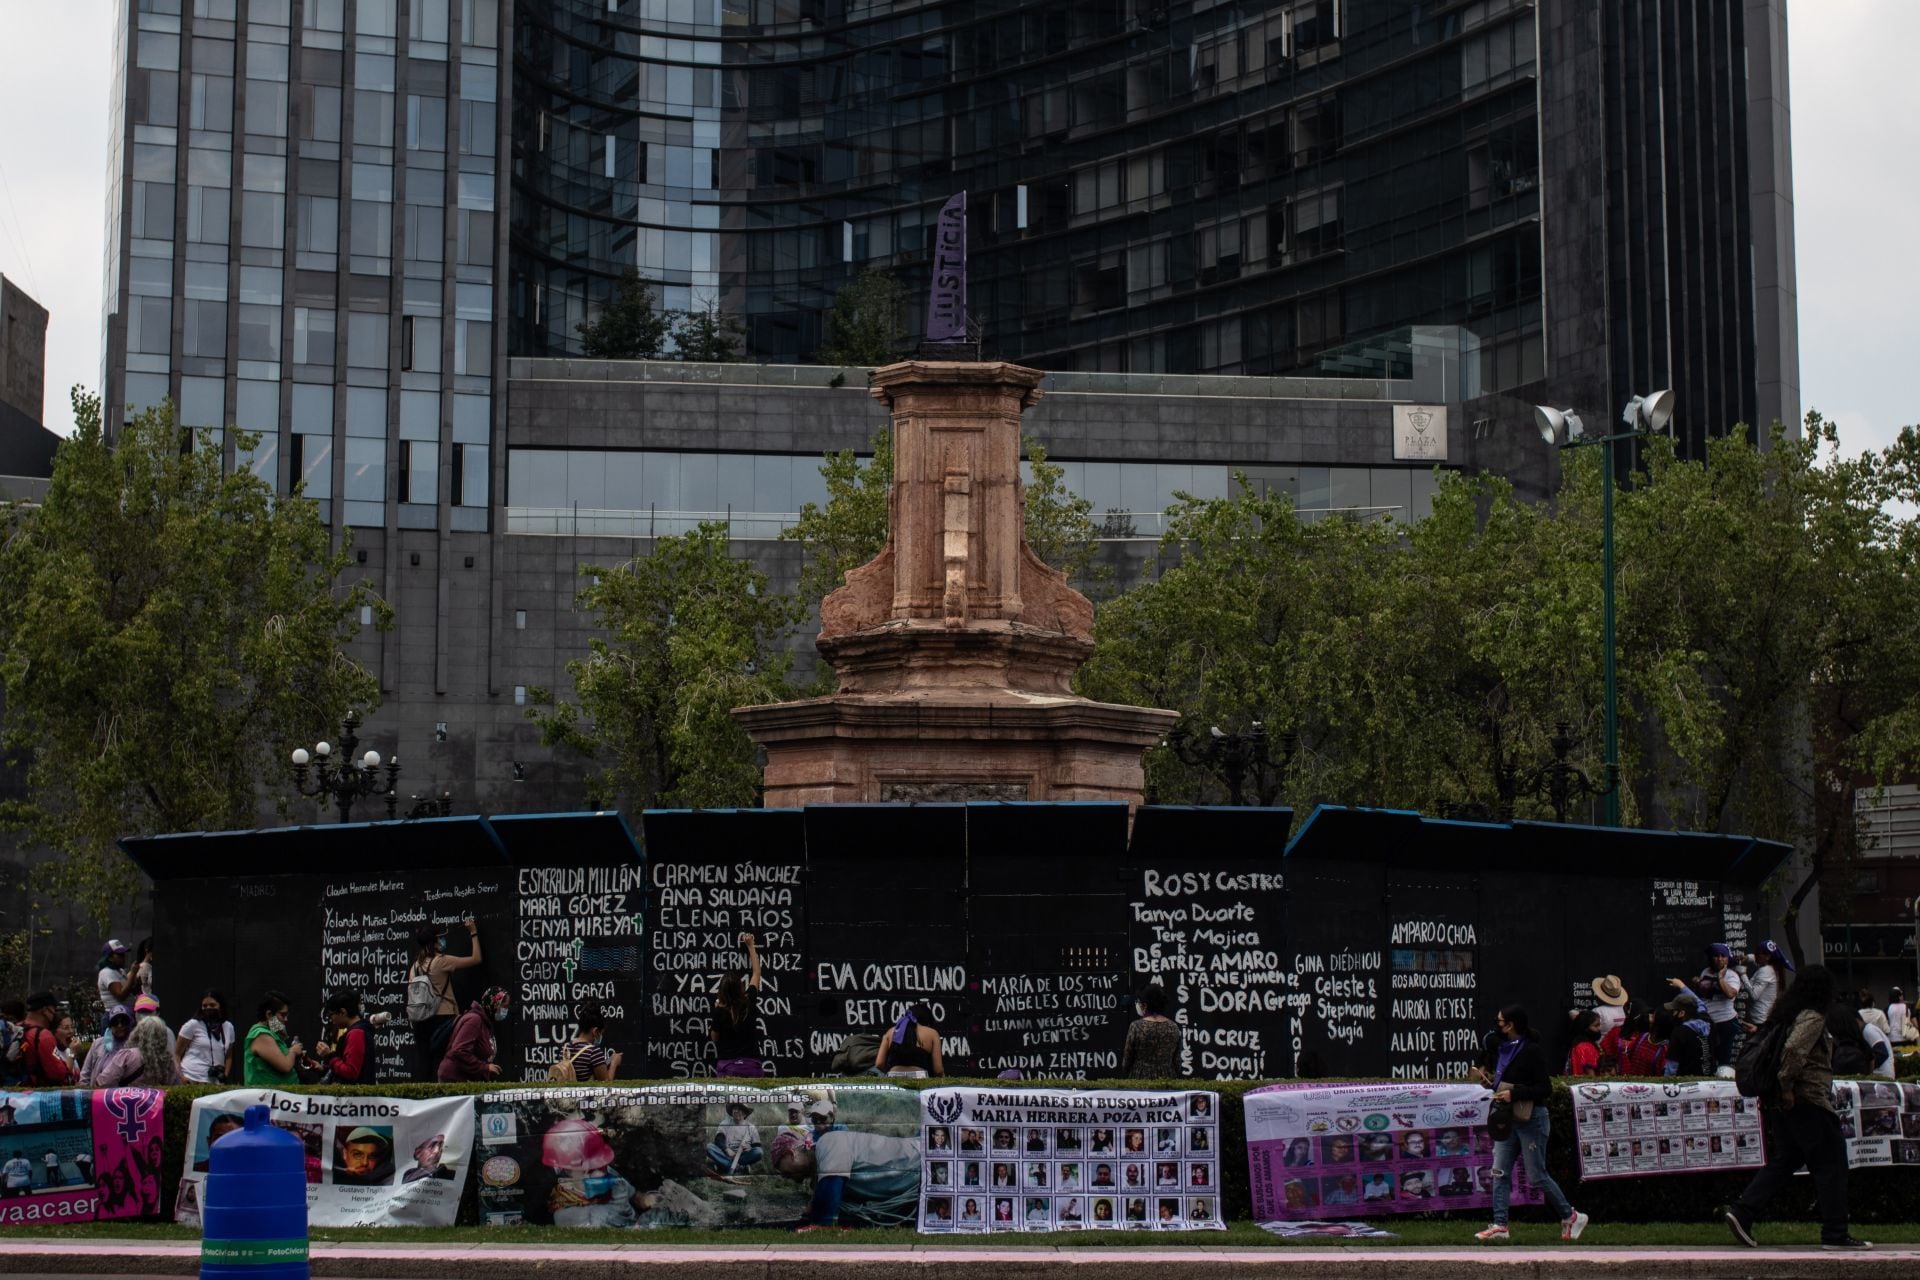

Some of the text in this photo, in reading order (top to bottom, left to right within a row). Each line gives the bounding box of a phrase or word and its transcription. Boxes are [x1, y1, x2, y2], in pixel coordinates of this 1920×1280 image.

[519, 863, 641, 895] ESMERALDA MILLÁN
[653, 861, 802, 887] CARMEN SÁNCHEZ
[519, 894, 626, 917] MARÍA GÓMEZ
[660, 886, 792, 907] ANA SALDAÑA
[325, 906, 359, 928] Yolanda
[362, 913, 388, 927] Muñoz
[660, 907, 793, 928] ELENA RÍOS
[1129, 901, 1255, 929] Tanya Duarte
[520, 917, 631, 937] KENYA MIREYA
[1152, 925, 1260, 950] Tere Mojica
[1391, 920, 1435, 944] AMPARO
[517, 940, 574, 961] CYNTHIA
[653, 931, 696, 949] ELISA
[362, 948, 408, 967] Patricia
[653, 951, 803, 972] GLORIA HERNNDEZ
[1133, 947, 1279, 973] BEATRIZ AMARO
[1295, 953, 1324, 975] GINA
[325, 968, 409, 987] Romero Hdez
[520, 961, 560, 981] GABY
[817, 962, 858, 992] EVA
[1391, 973, 1428, 989] ROSARIO
[521, 981, 615, 1002] SAYURI GARZA
[982, 974, 1084, 995] MARÍA DE LOS
[1315, 973, 1364, 998] Celeste
[651, 992, 711, 1016] BLANCA
[995, 993, 1118, 1013] ÁNGELES CASTILLO
[1200, 987, 1262, 1012] DORA
[1317, 997, 1376, 1022] Stephanie
[1391, 998, 1431, 1020] AURORA
[1435, 997, 1467, 1020] REYES
[522, 1004, 569, 1021] MARIANA
[845, 1000, 888, 1025] BETY
[985, 1014, 1109, 1032] LILIANA VELÁSQUEZ
[534, 1023, 580, 1044] LUZ
[1022, 1027, 1090, 1047] FUENTES
[1215, 1029, 1261, 1051] CRUZ
[1391, 1026, 1479, 1052] ALAÍDE FOPPA
[524, 1046, 560, 1064] LESLIE
[647, 1039, 718, 1061] MICAELA
[940, 1035, 971, 1058] APIA
[978, 1051, 1118, 1069] CLAUDIA ZENTENO
[271, 1093, 400, 1118] Los buscamos
[483, 1090, 541, 1103] Brigada
[543, 1087, 609, 1099] Nacional
[648, 1096, 666, 1105] De
[669, 1095, 726, 1105] Enlaces
[977, 1093, 1178, 1109] FAMILIARES EN BUSQUEDA
[971, 1109, 1183, 1123] MARIA HERRERA POZA RICA
